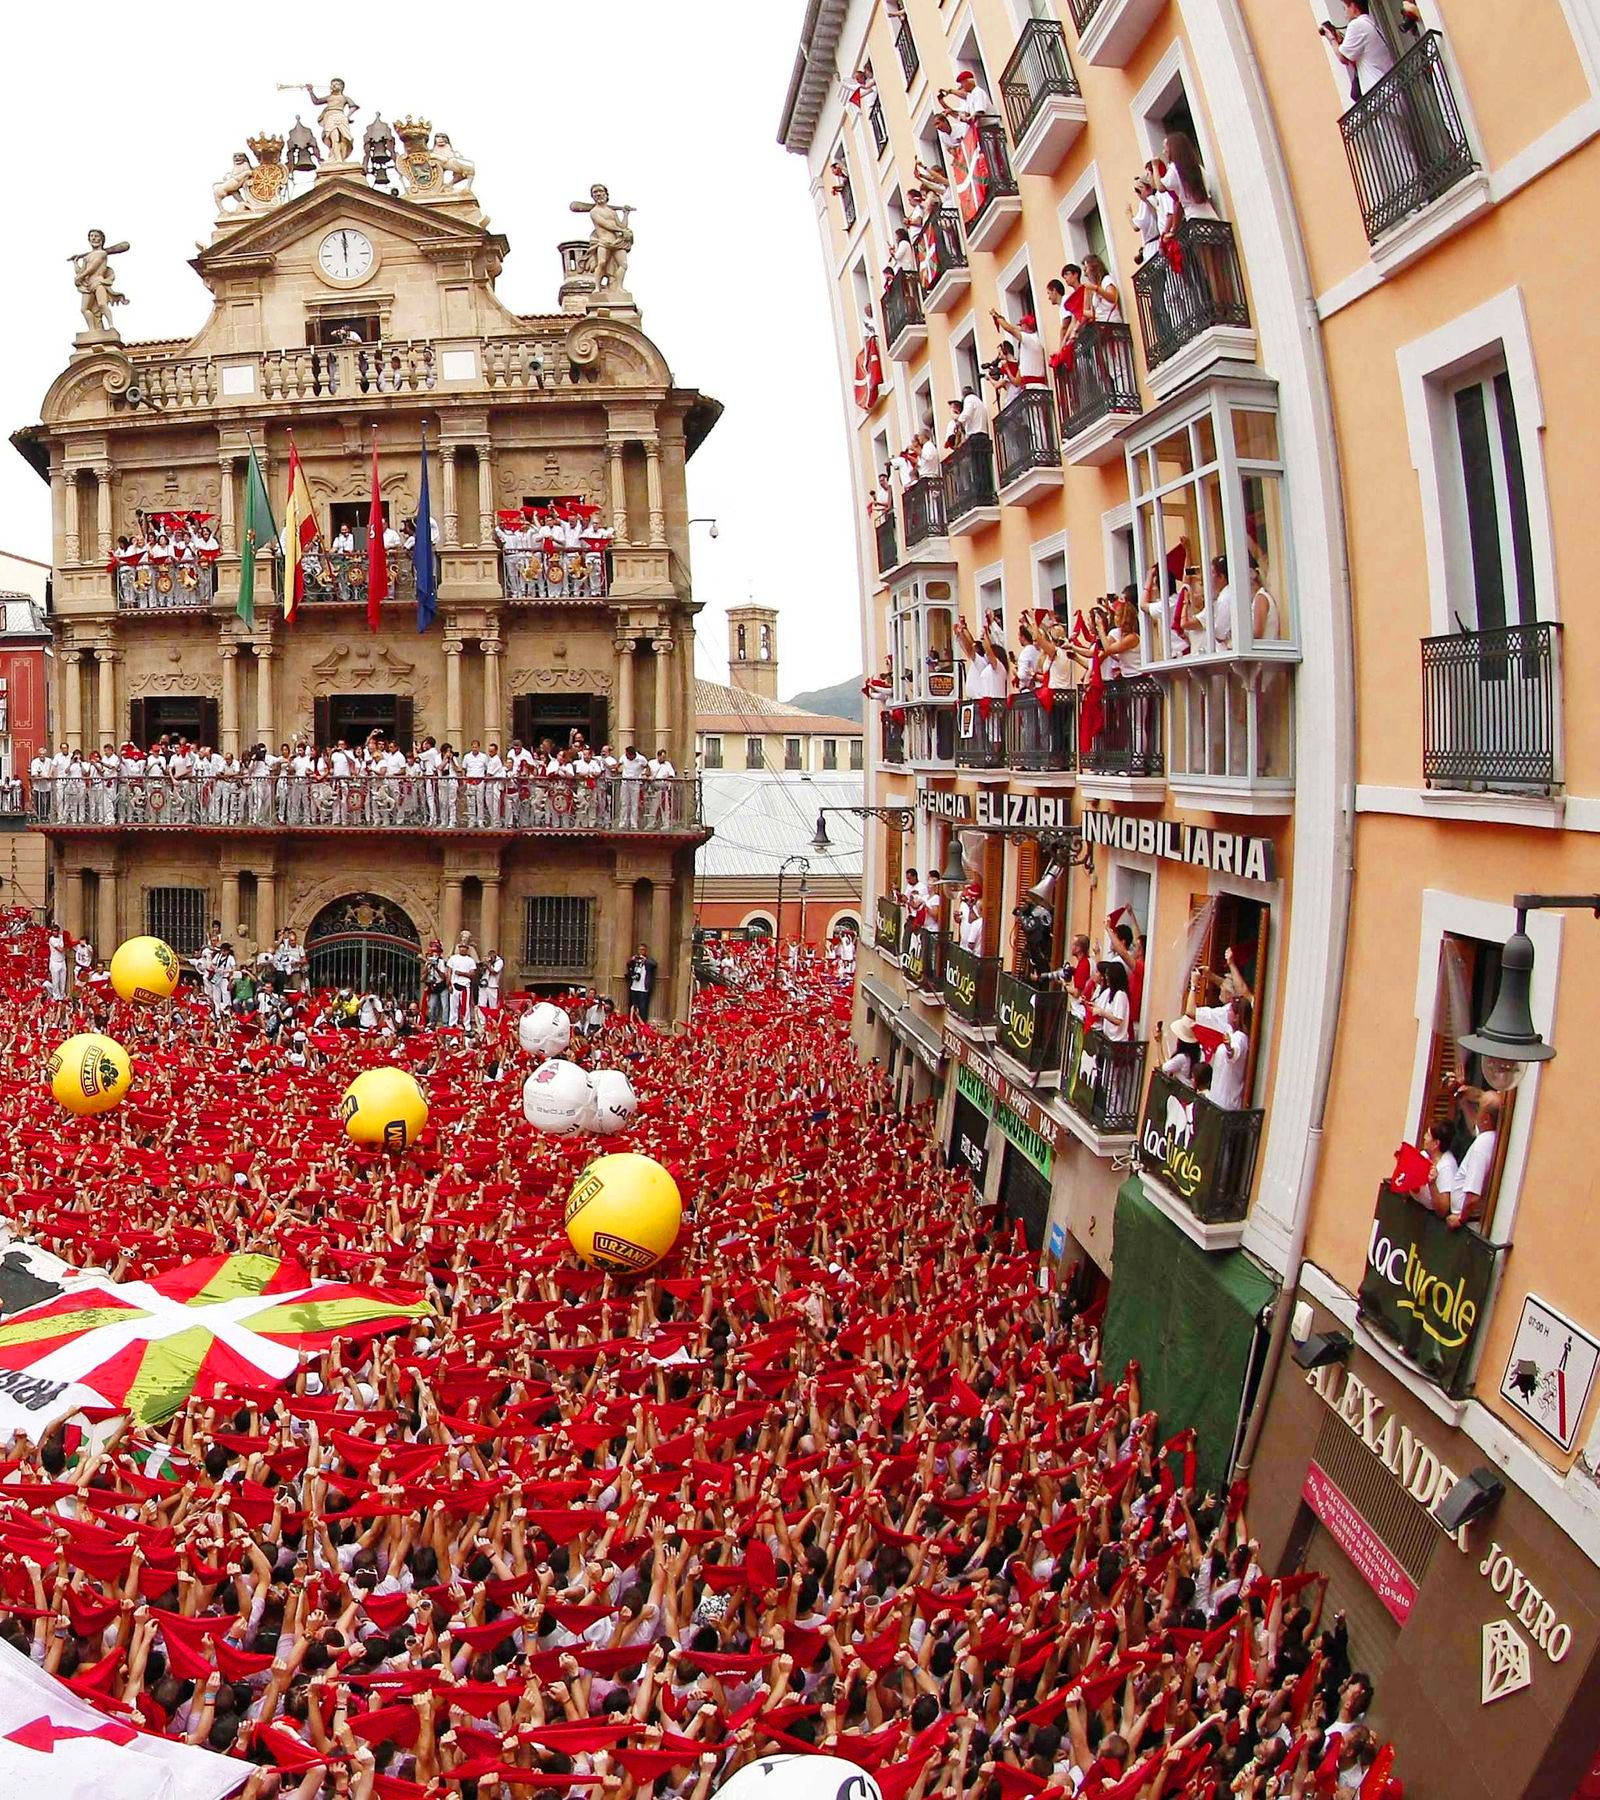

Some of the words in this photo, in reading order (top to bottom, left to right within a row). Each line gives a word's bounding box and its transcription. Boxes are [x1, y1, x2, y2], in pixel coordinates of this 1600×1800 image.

[915, 790, 965, 818] AGENCIA
[976, 792, 1063, 826] ELIZARI
[1082, 811, 1267, 881] INMOBILIARIA
[84, 1047, 102, 1093] URZANTE
[999, 1101, 1047, 1165] ESCUENTOS
[599, 1237, 653, 1265] URZANTE
[1322, 1482, 1361, 1534] DESCUENTOS
[1361, 1531, 1399, 1582] ESPECIALES
[1324, 1500, 1336, 1517] POR
[1335, 1510, 1357, 1543] CAMBIO
[1356, 1538, 1365, 1552] DE
[1364, 1549, 1389, 1583] NEGOCIO
[1331, 1521, 1345, 1543] TODA
[1378, 1582, 1410, 1607] 50%dto
[1479, 1542, 1573, 1662] JOYERO
